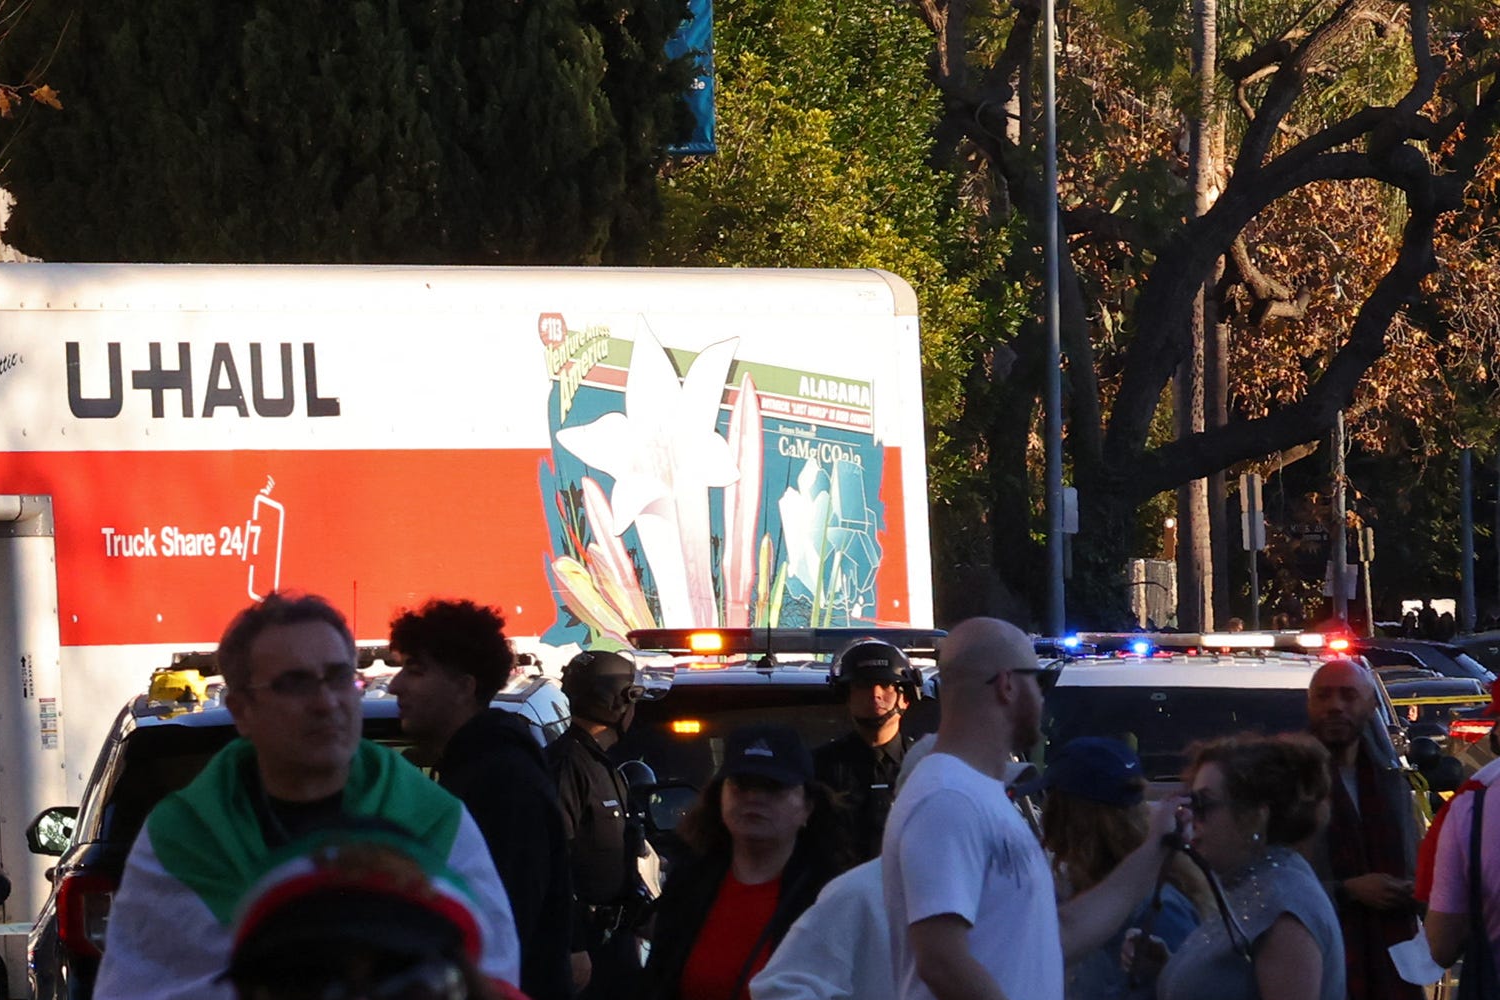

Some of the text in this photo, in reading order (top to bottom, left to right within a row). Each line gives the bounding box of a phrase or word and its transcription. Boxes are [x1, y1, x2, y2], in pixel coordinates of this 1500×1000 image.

[799, 376, 871, 407] ALABAMA
[101, 520, 262, 561] Truck Share 24/7
